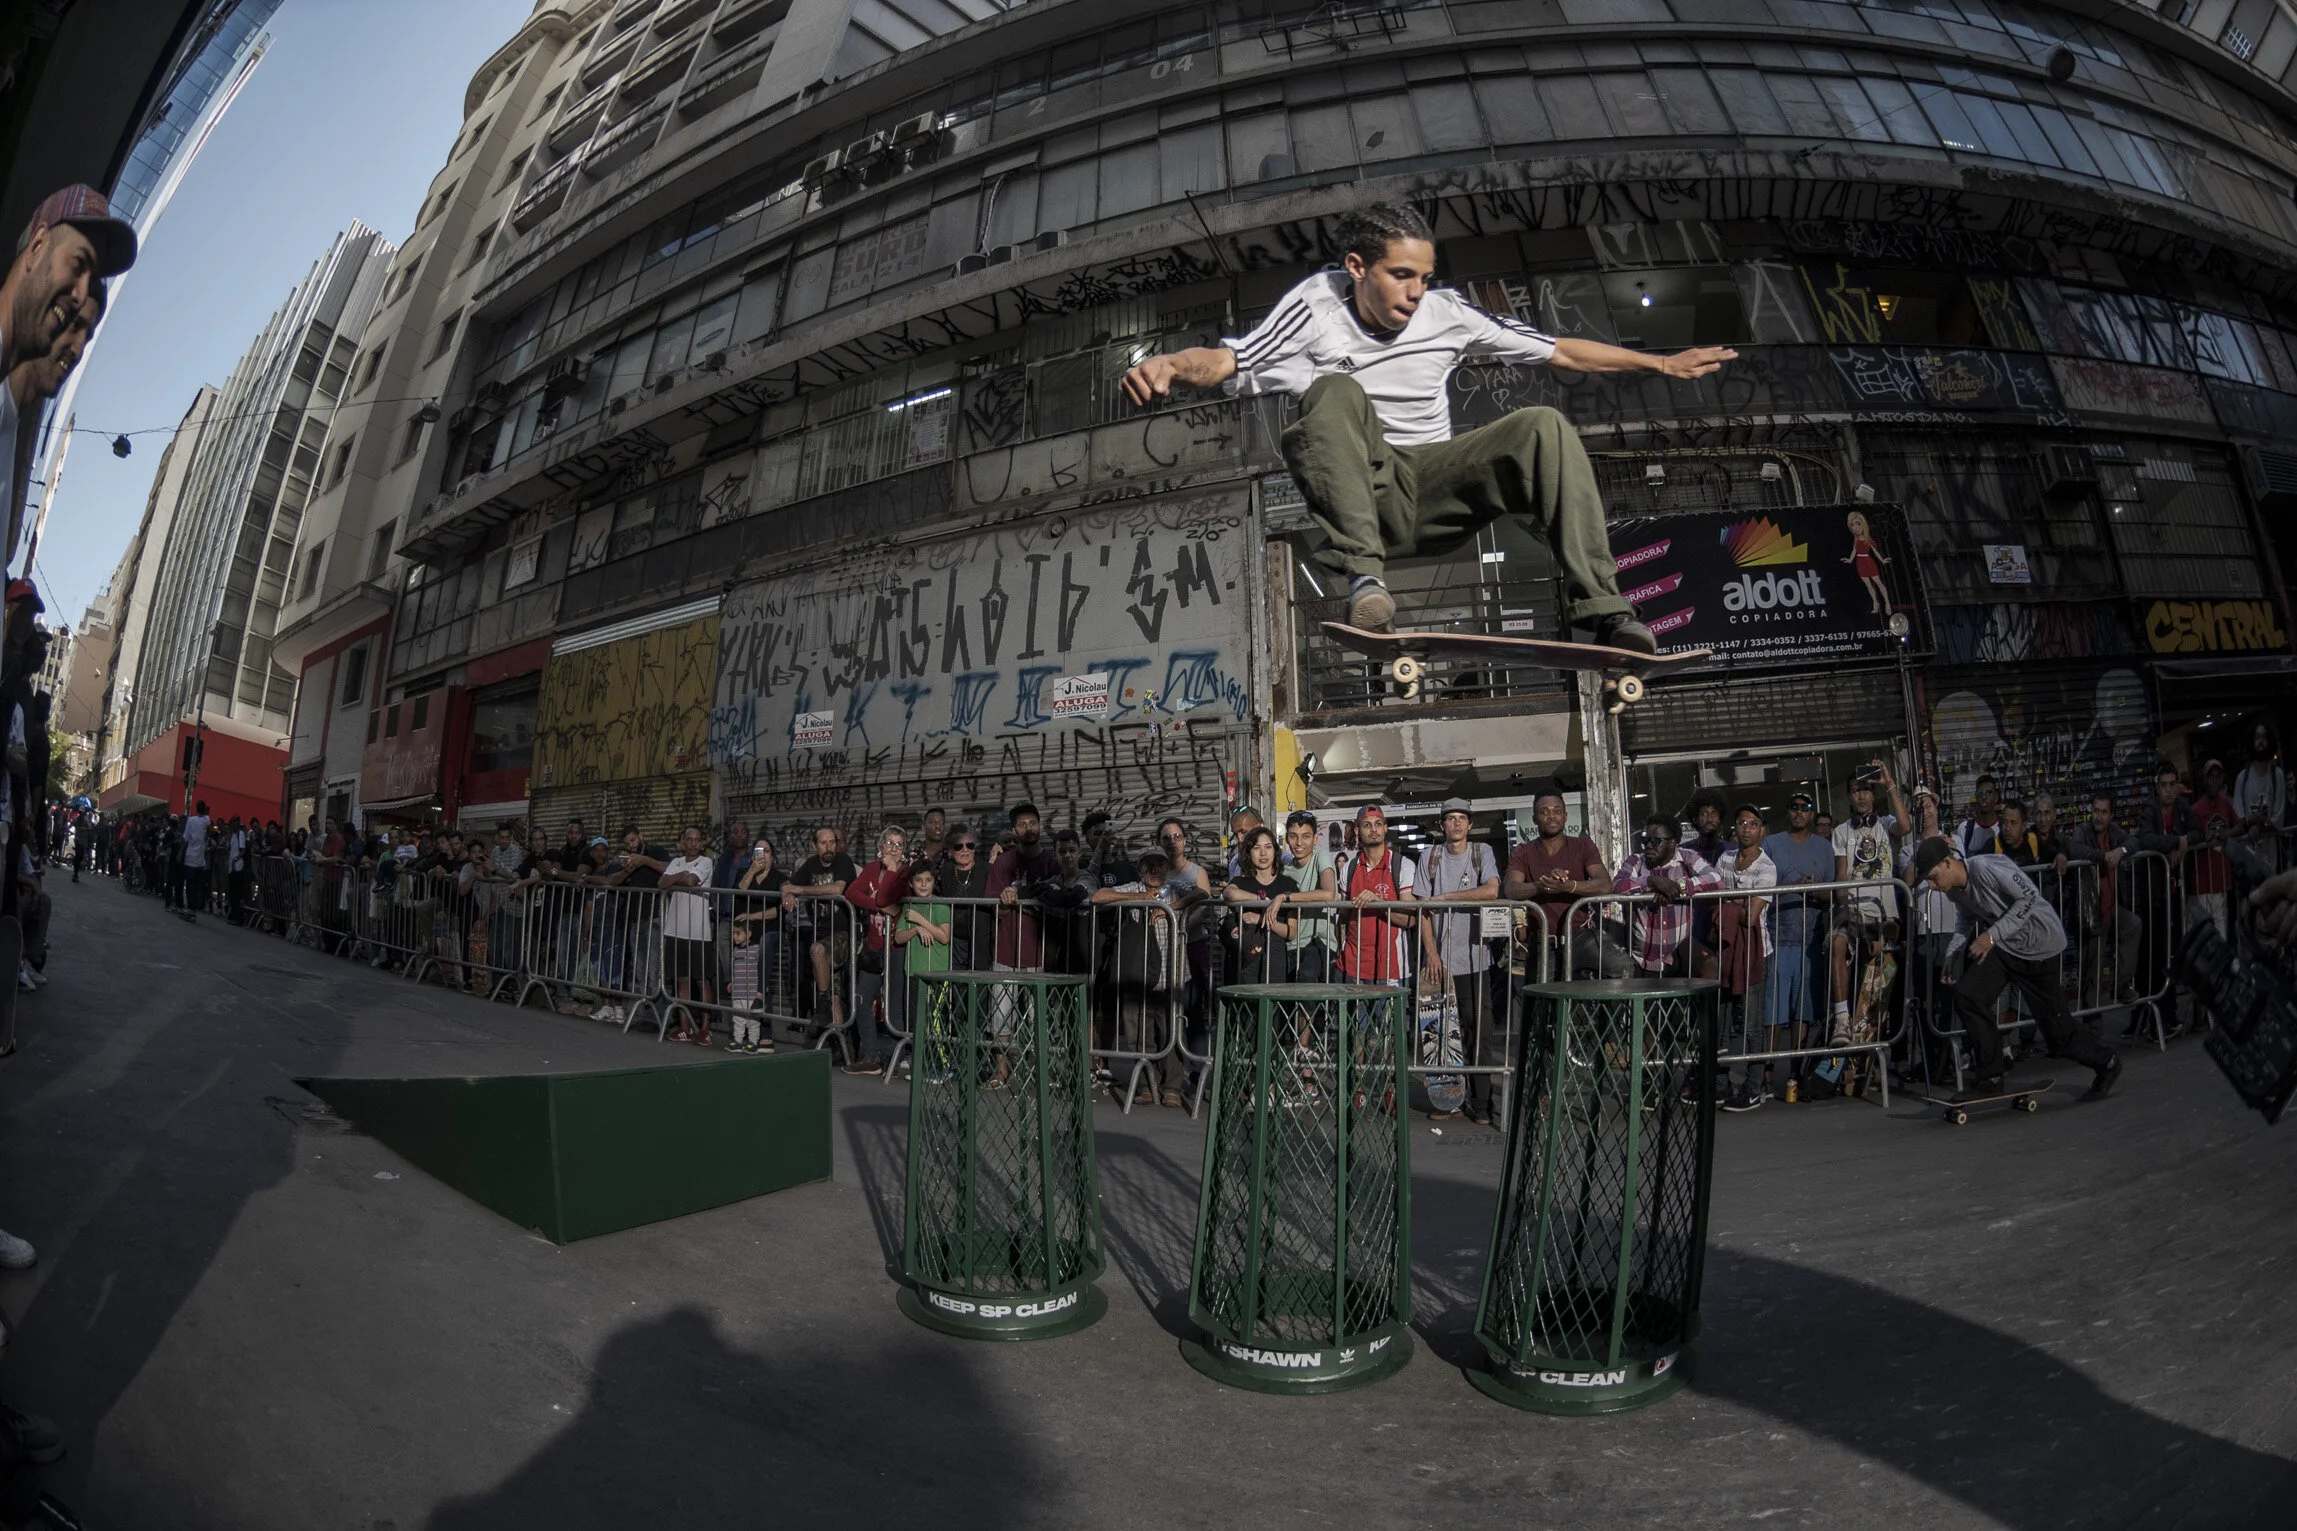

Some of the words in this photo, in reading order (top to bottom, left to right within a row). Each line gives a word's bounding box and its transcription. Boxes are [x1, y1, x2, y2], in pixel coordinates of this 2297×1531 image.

[1722, 569, 1826, 612] aldott
[1729, 610, 1828, 624] COPIADORA
[2145, 600, 2286, 653] CENTRAL
[1750, 635, 1795, 646] 3334-0352
[1804, 631, 1848, 643] 3337-6135
[1857, 628, 1893, 640] 97665-67
[1732, 643, 1863, 661] contato@aldottcopiadora.com.br
[1065, 682, 1074, 695] J.
[1076, 682, 1106, 694] Nicolau
[1055, 696, 1106, 709] ALUGA
[803, 717, 809, 728] J.
[811, 719, 832, 728] Nicolau
[795, 731, 831, 740] ALUGA
[929, 1291, 976, 1313] KEEP
[979, 1305, 1011, 1318] SP
[1015, 1292, 1077, 1317] CLEAN
[1540, 1370, 1626, 1386] CLEAN
